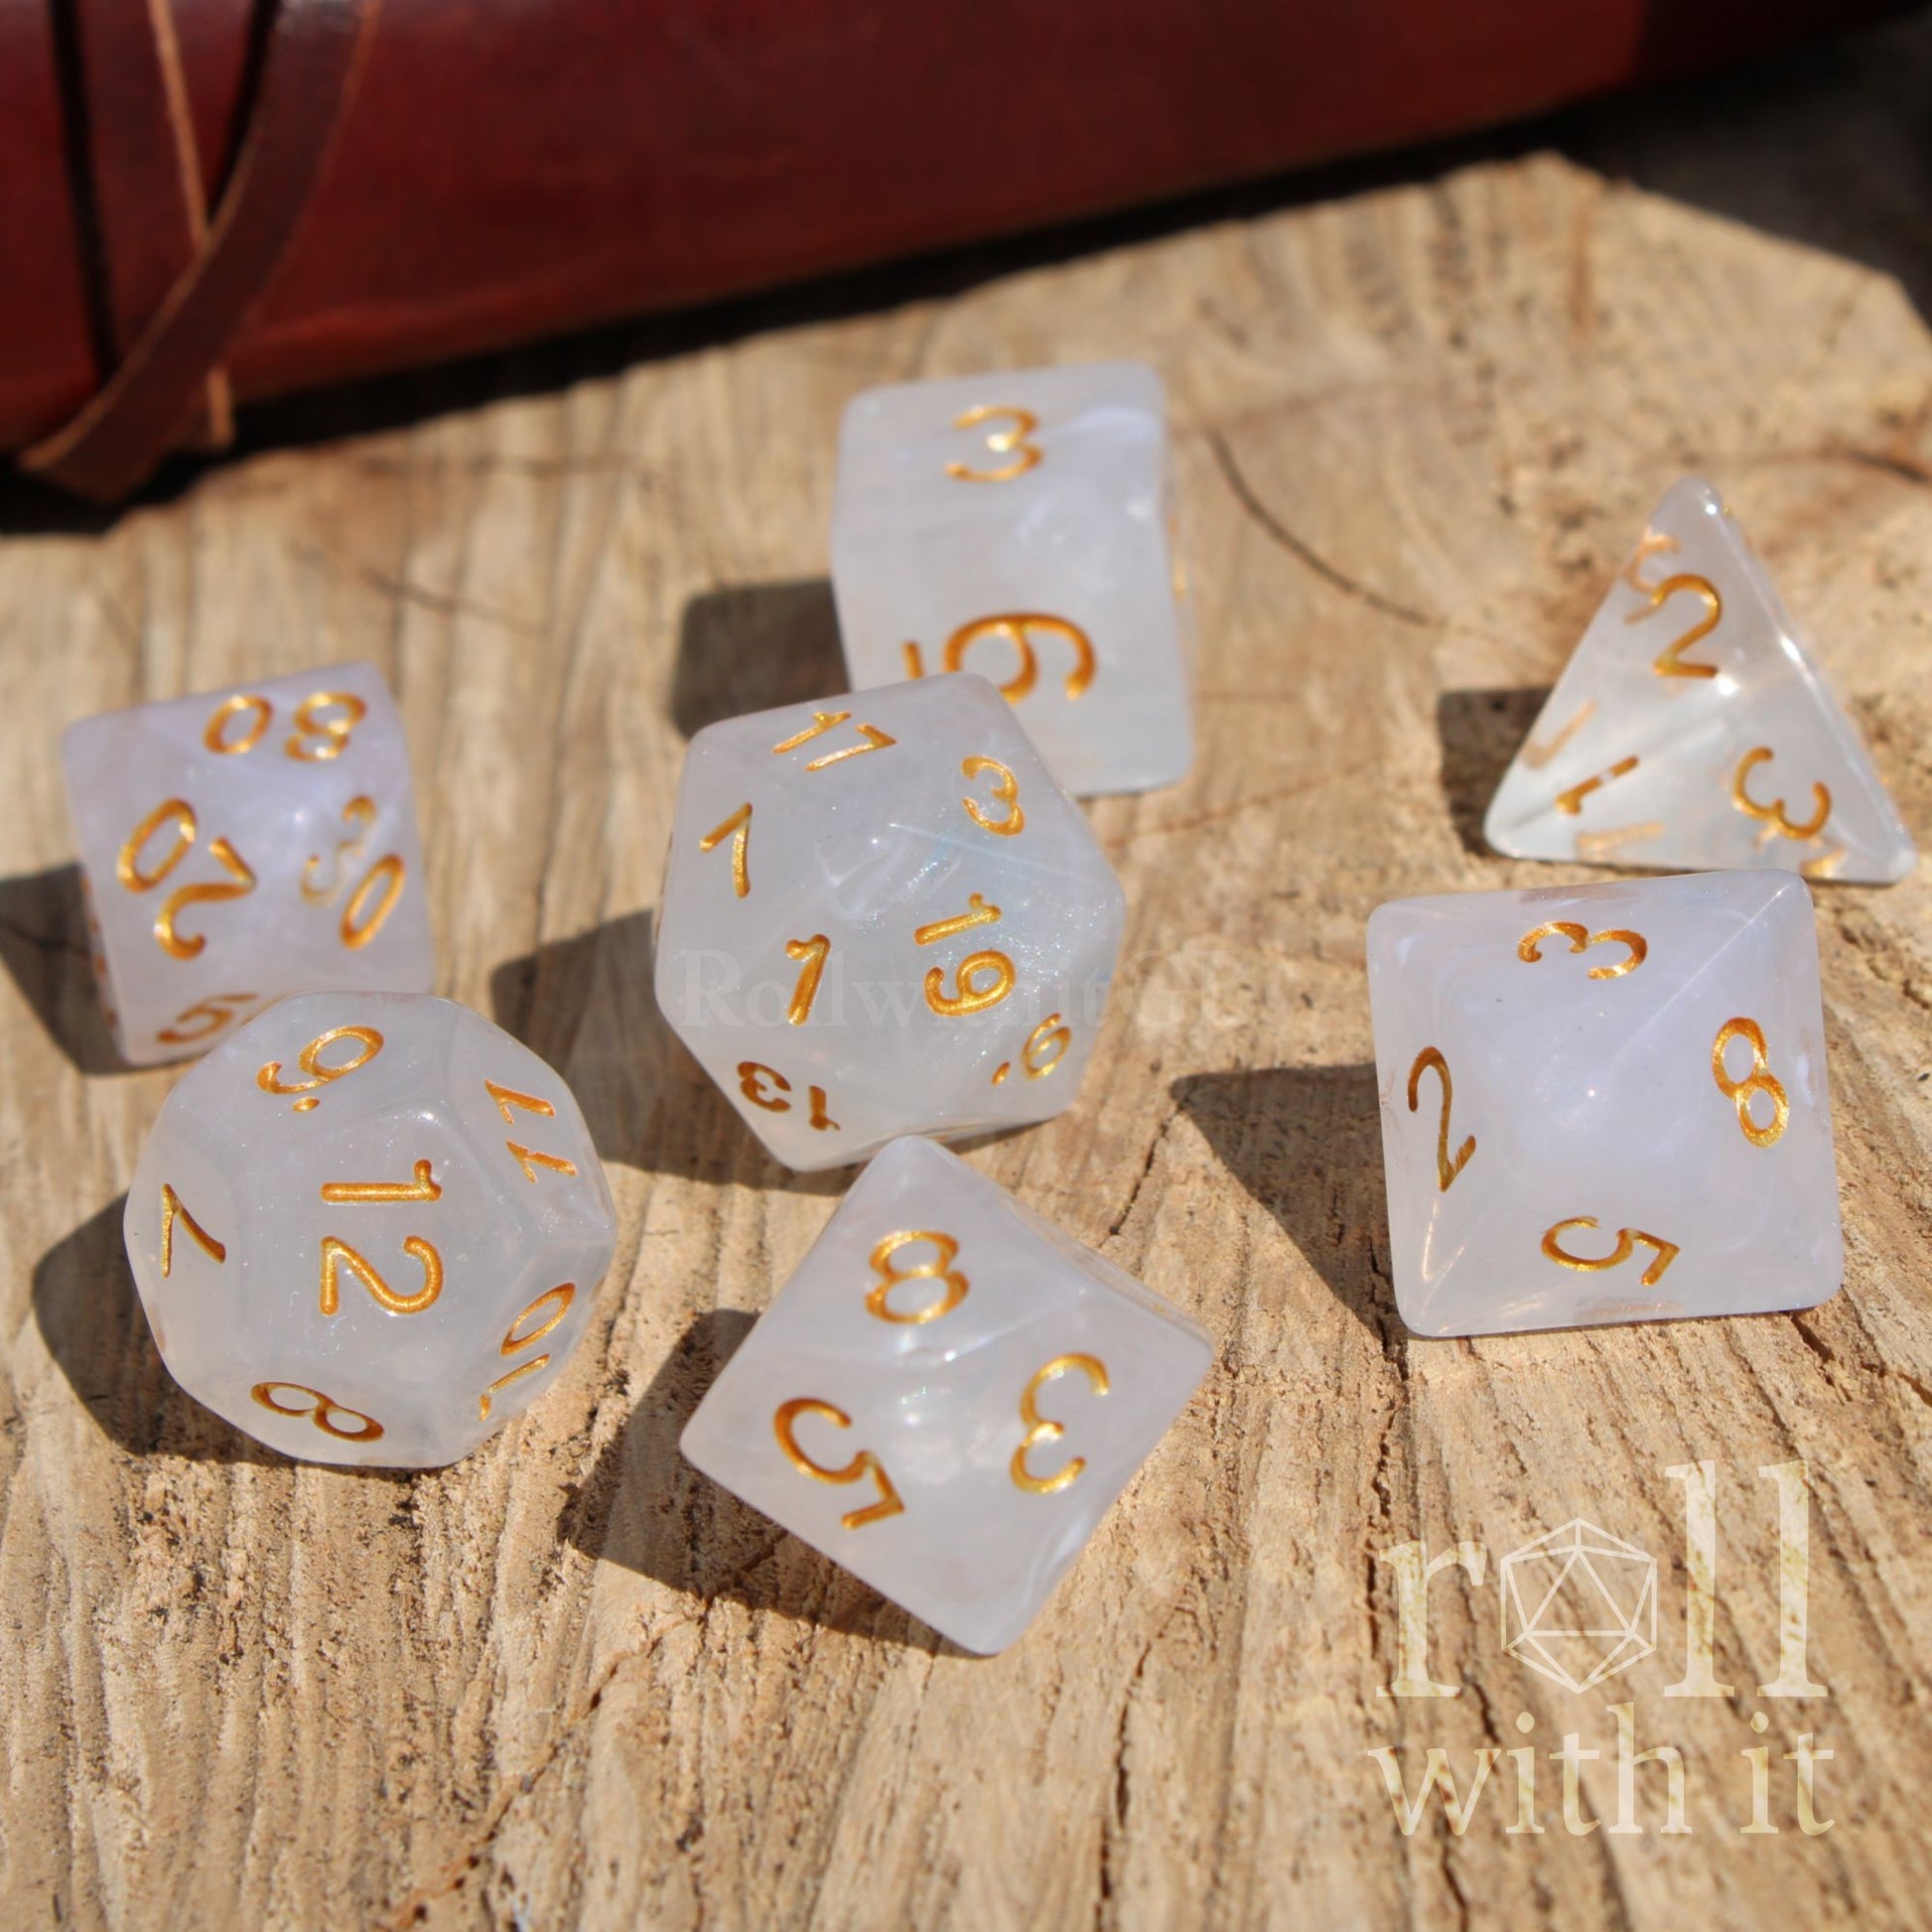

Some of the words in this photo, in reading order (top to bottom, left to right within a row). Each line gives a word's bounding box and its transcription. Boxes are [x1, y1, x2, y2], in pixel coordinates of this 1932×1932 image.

[947, 407, 1043, 482] 3
[1650, 572, 1724, 677] 2
[203, 692, 366, 761] 80
[772, 712, 897, 772] 17
[961, 756, 1026, 837] 3
[1555, 756, 1638, 816] 1
[1731, 747, 1832, 840] 3
[700, 803, 753, 898] 7
[784, 934, 831, 1025] 1
[913, 893, 1016, 1018] 19
[1517, 921, 1648, 980] 3
[737, 1061, 840, 1131] 13
[1407, 1046, 1476, 1191] 2
[1712, 1017, 1789, 1148] 8
[484, 1079, 577, 1182] 11
[319, 1159, 444, 1316] 12
[864, 1230, 970, 1324] 8
[1541, 1216, 1680, 1287] 5
[479, 1283, 576, 1422] 10
[251, 1382, 384, 1442] 8
[1010, 1352, 1111, 1494] 3
[773, 1398, 905, 1529] 5
